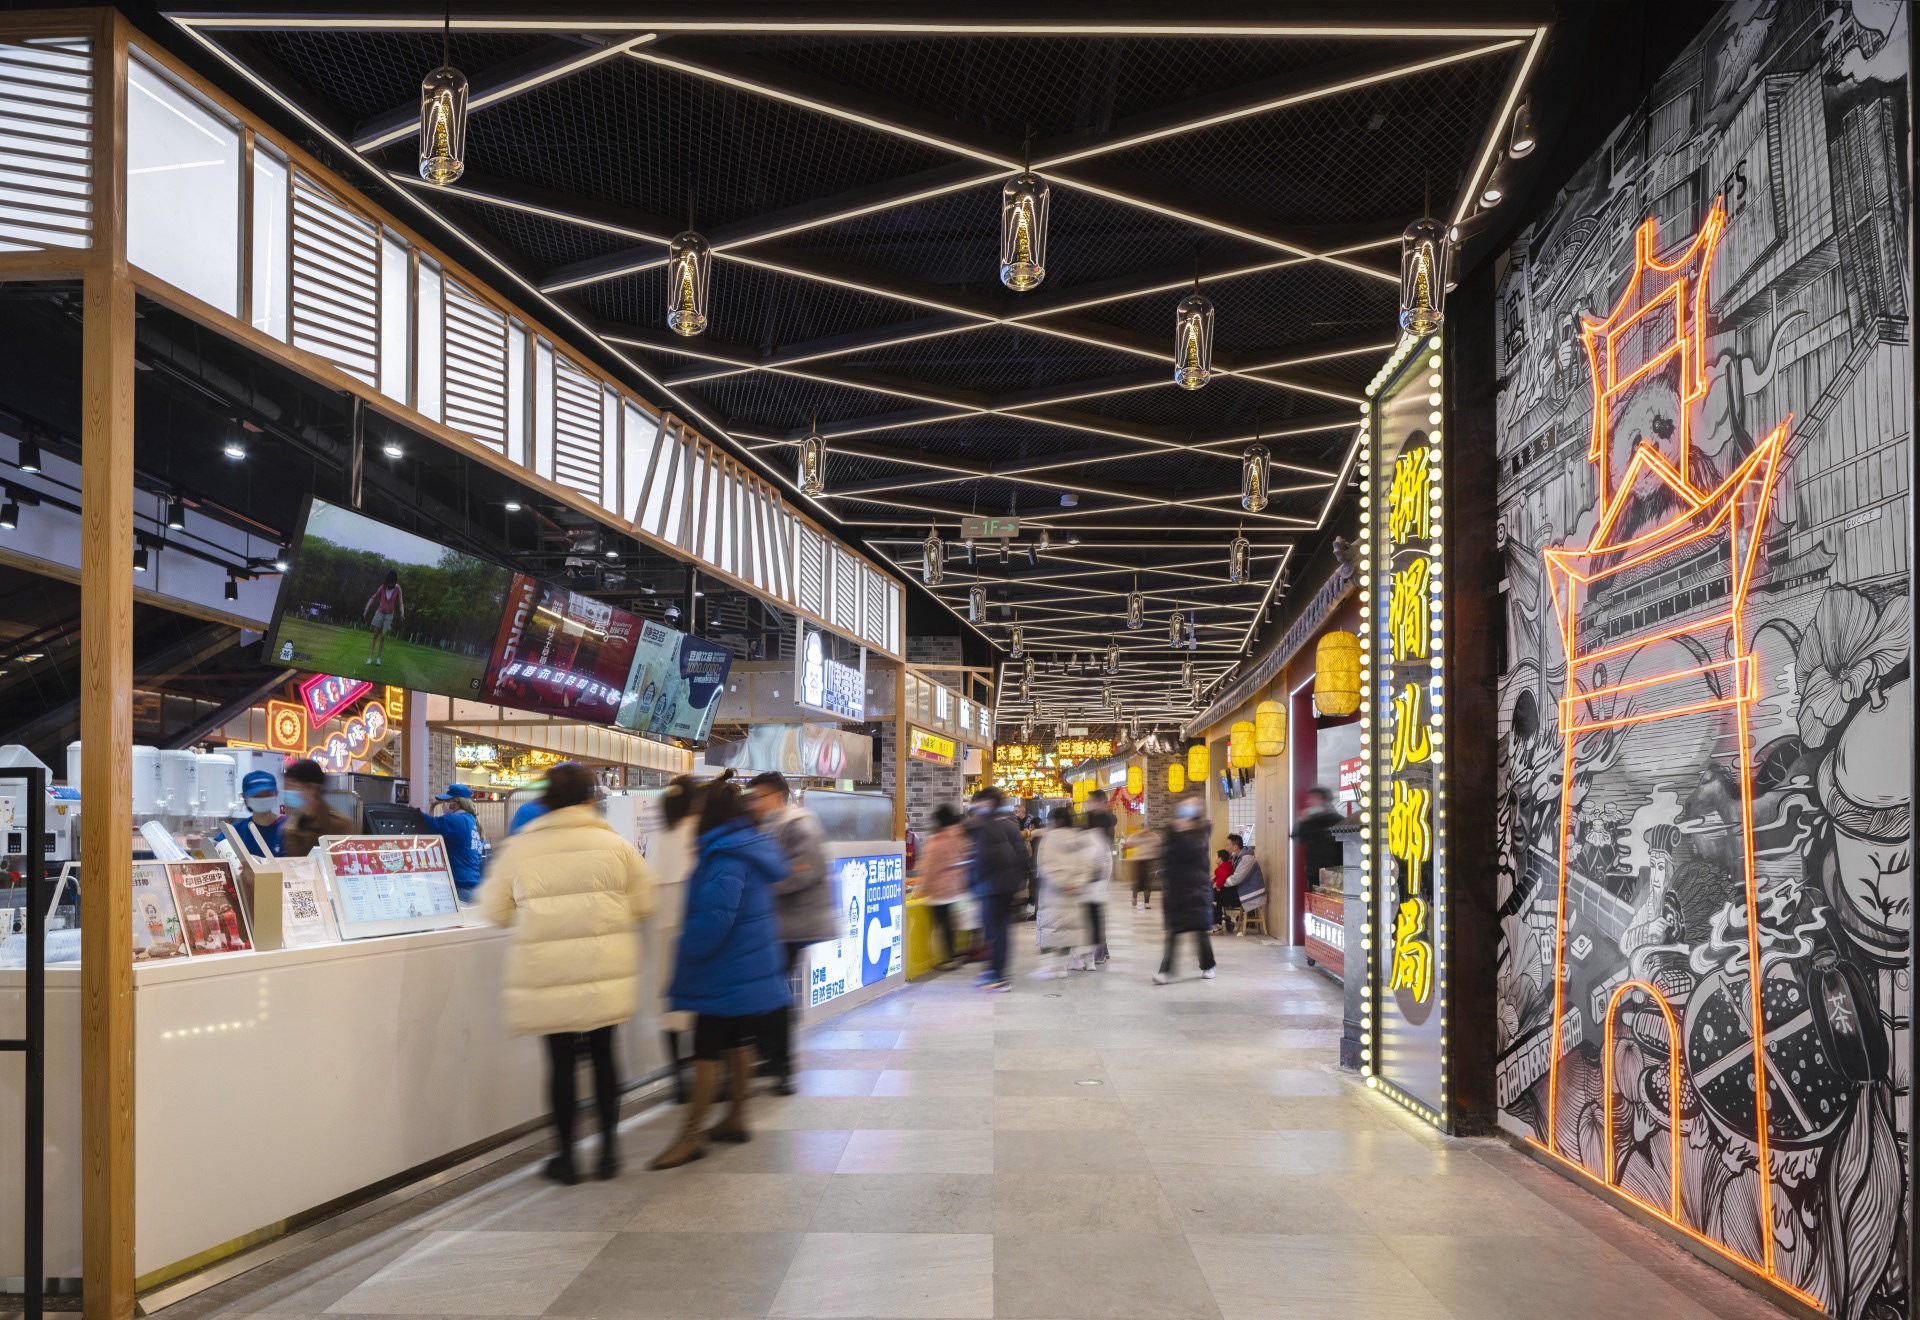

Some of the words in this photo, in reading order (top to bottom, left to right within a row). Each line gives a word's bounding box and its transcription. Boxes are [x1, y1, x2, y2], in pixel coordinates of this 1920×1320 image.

[1718, 159, 1747, 216] FS
[1846, 511, 1874, 528] GUCCI
[868, 858, 902, 884] 豆腐饮品
[866, 883, 902, 902] 1000.0000+
[812, 978, 845, 1005] 自然受欢迎
[1827, 992, 1853, 1036] 茶
